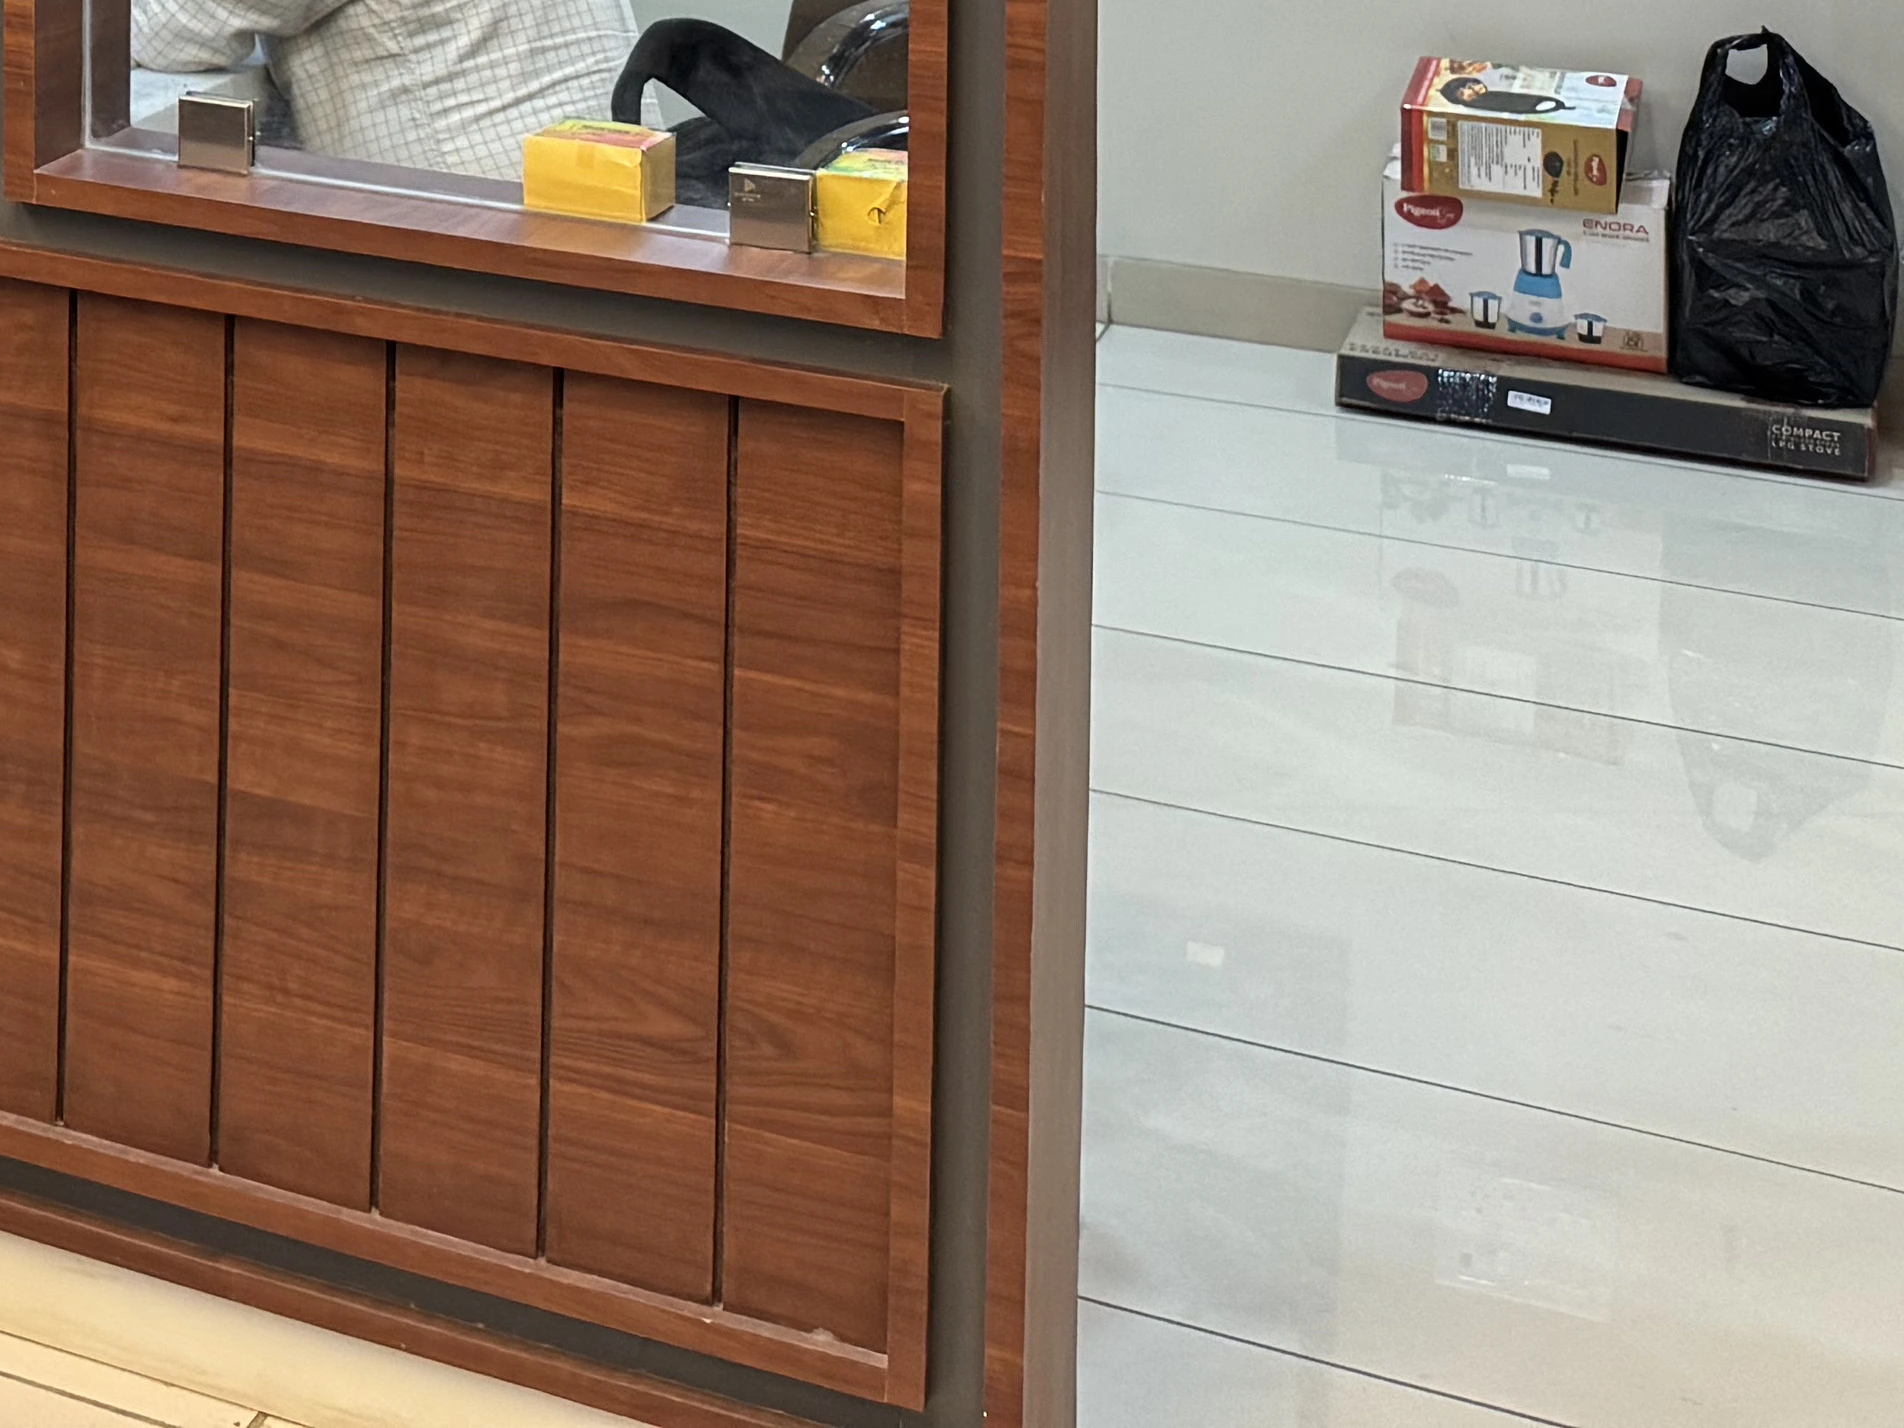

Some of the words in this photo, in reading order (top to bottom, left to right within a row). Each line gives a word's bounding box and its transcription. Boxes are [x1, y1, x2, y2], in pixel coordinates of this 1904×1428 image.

[1583, 218, 1649, 235] ENORA
[1772, 424, 1841, 442] COMPACT
[1800, 443, 1841, 456] STOVE
